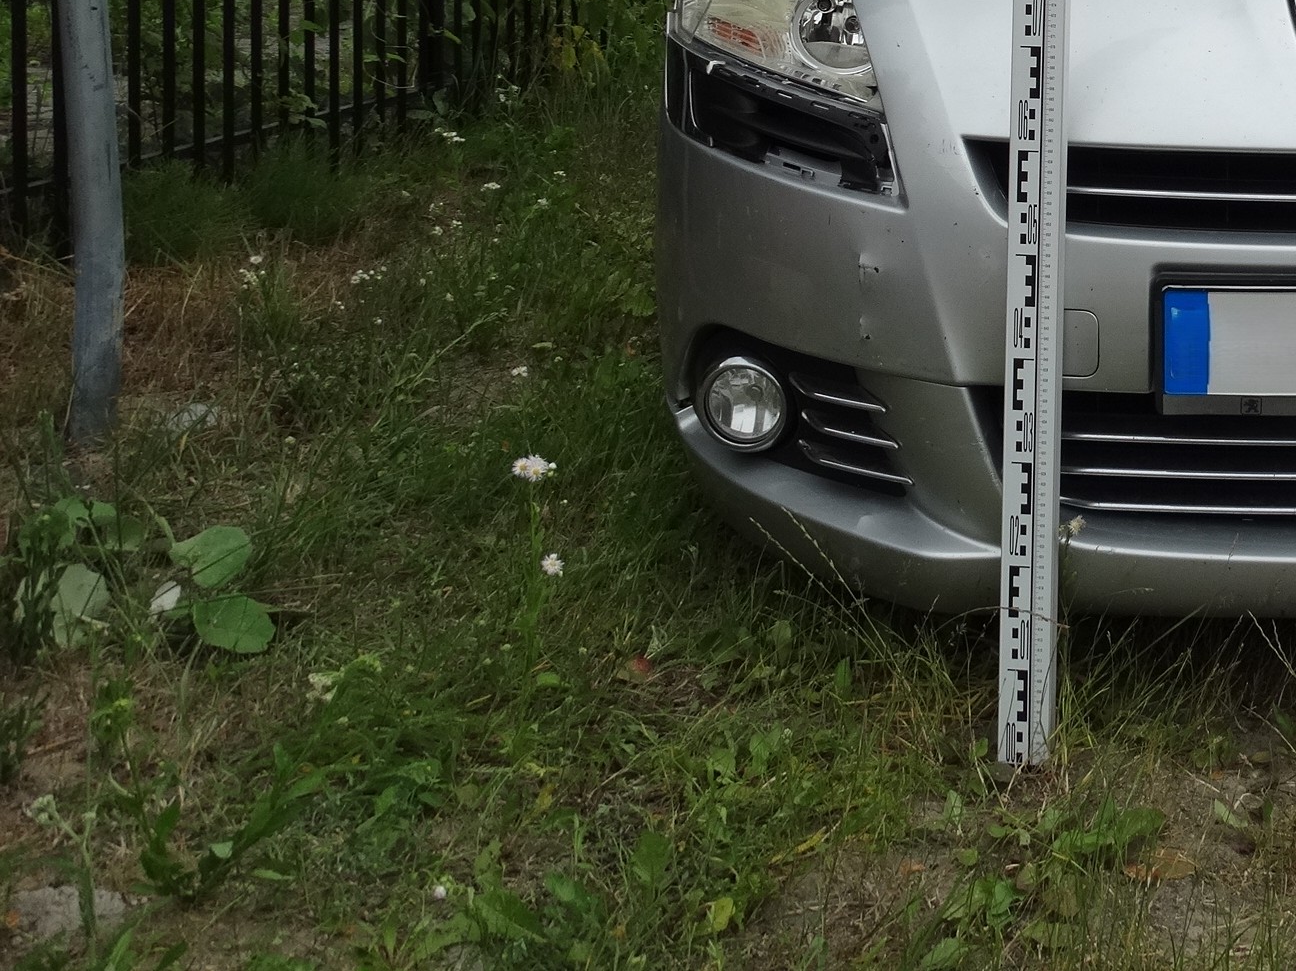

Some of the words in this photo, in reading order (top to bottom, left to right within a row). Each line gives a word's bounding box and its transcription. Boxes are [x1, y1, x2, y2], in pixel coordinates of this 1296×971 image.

[1018, 99, 1028, 140] 06
[1027, 204, 1037, 245] 05
[1013, 308, 1023, 348] 04
[1023, 412, 1033, 452] 03
[1009, 515, 1019, 556] 02
[1020, 619, 1029, 660] 01
[1006, 722, 1015, 763] 00
